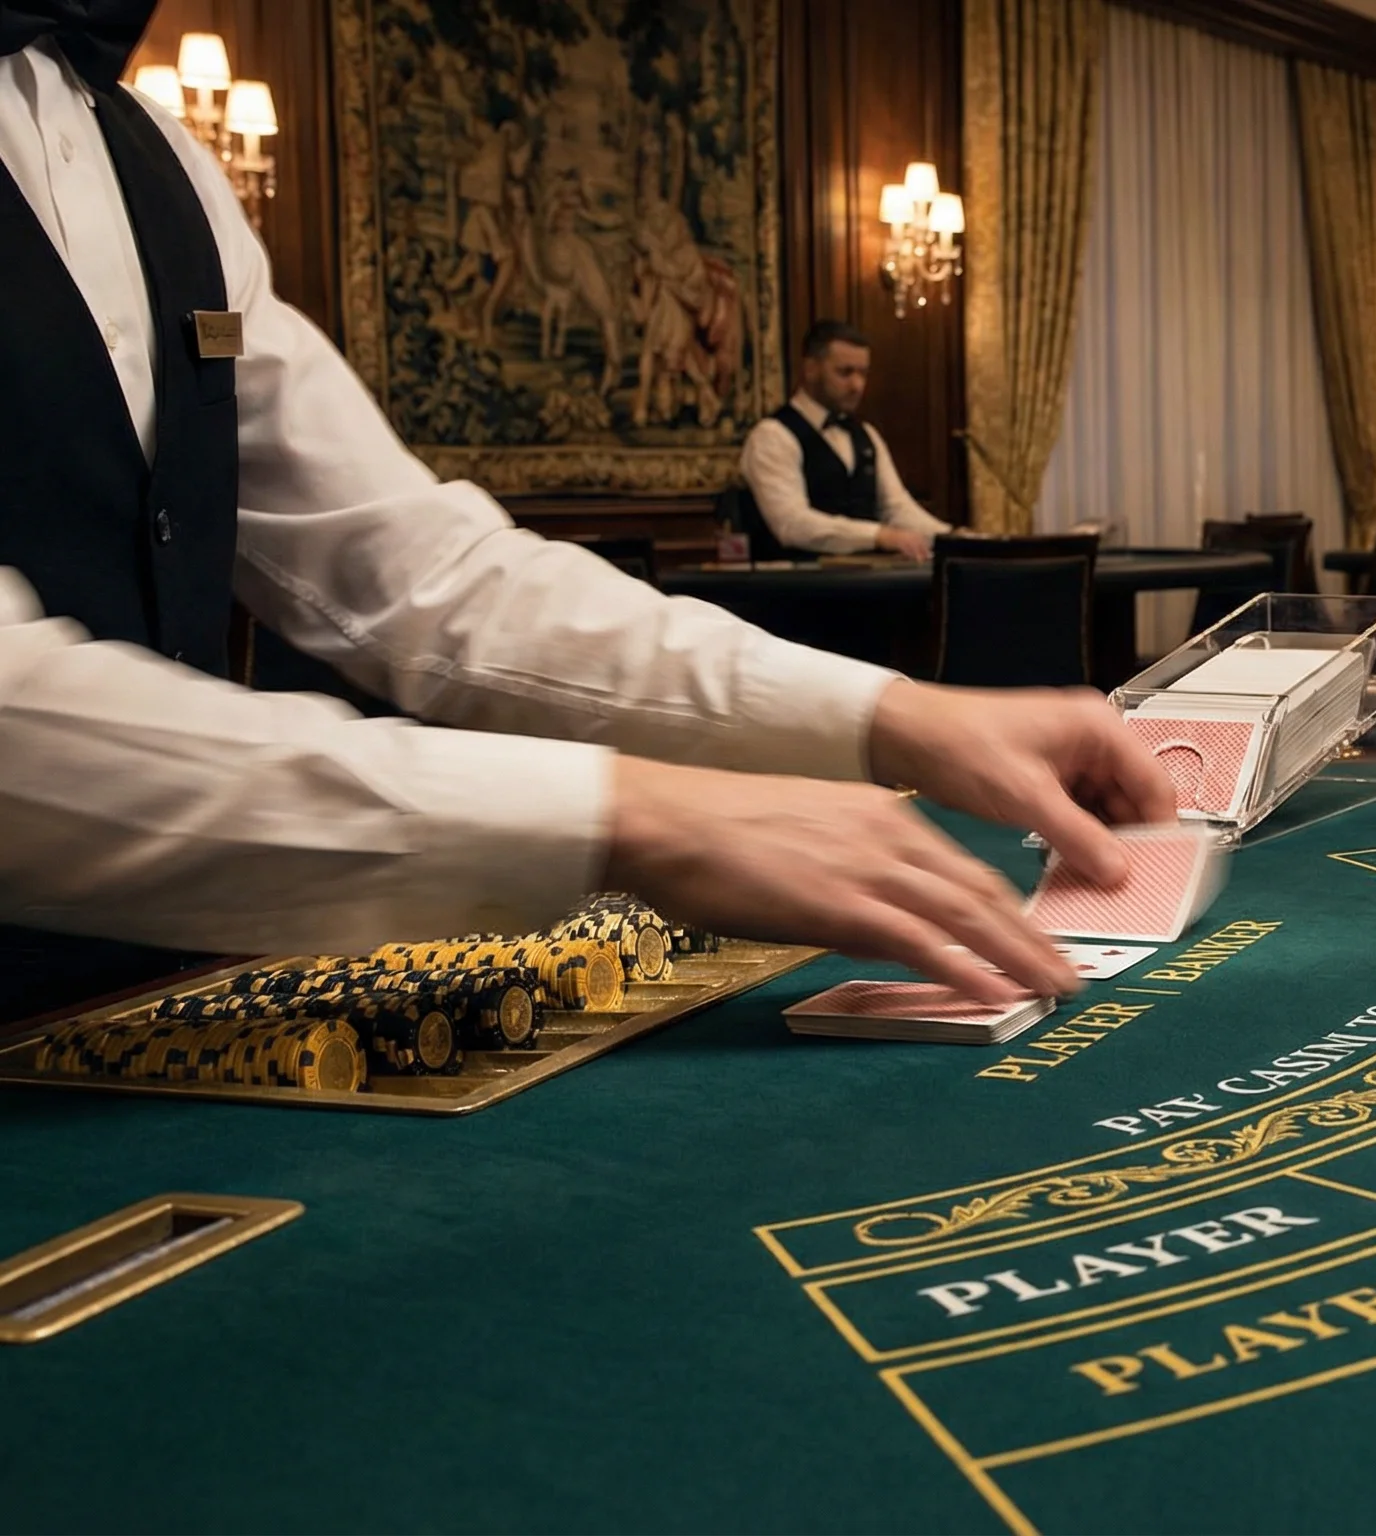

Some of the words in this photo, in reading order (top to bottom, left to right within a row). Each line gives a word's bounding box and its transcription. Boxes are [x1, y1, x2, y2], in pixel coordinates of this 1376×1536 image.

[974, 1000, 1155, 1083] PLAYER
[1142, 919, 1284, 983] BANKER
[917, 1205, 1320, 1317] PLAYER
